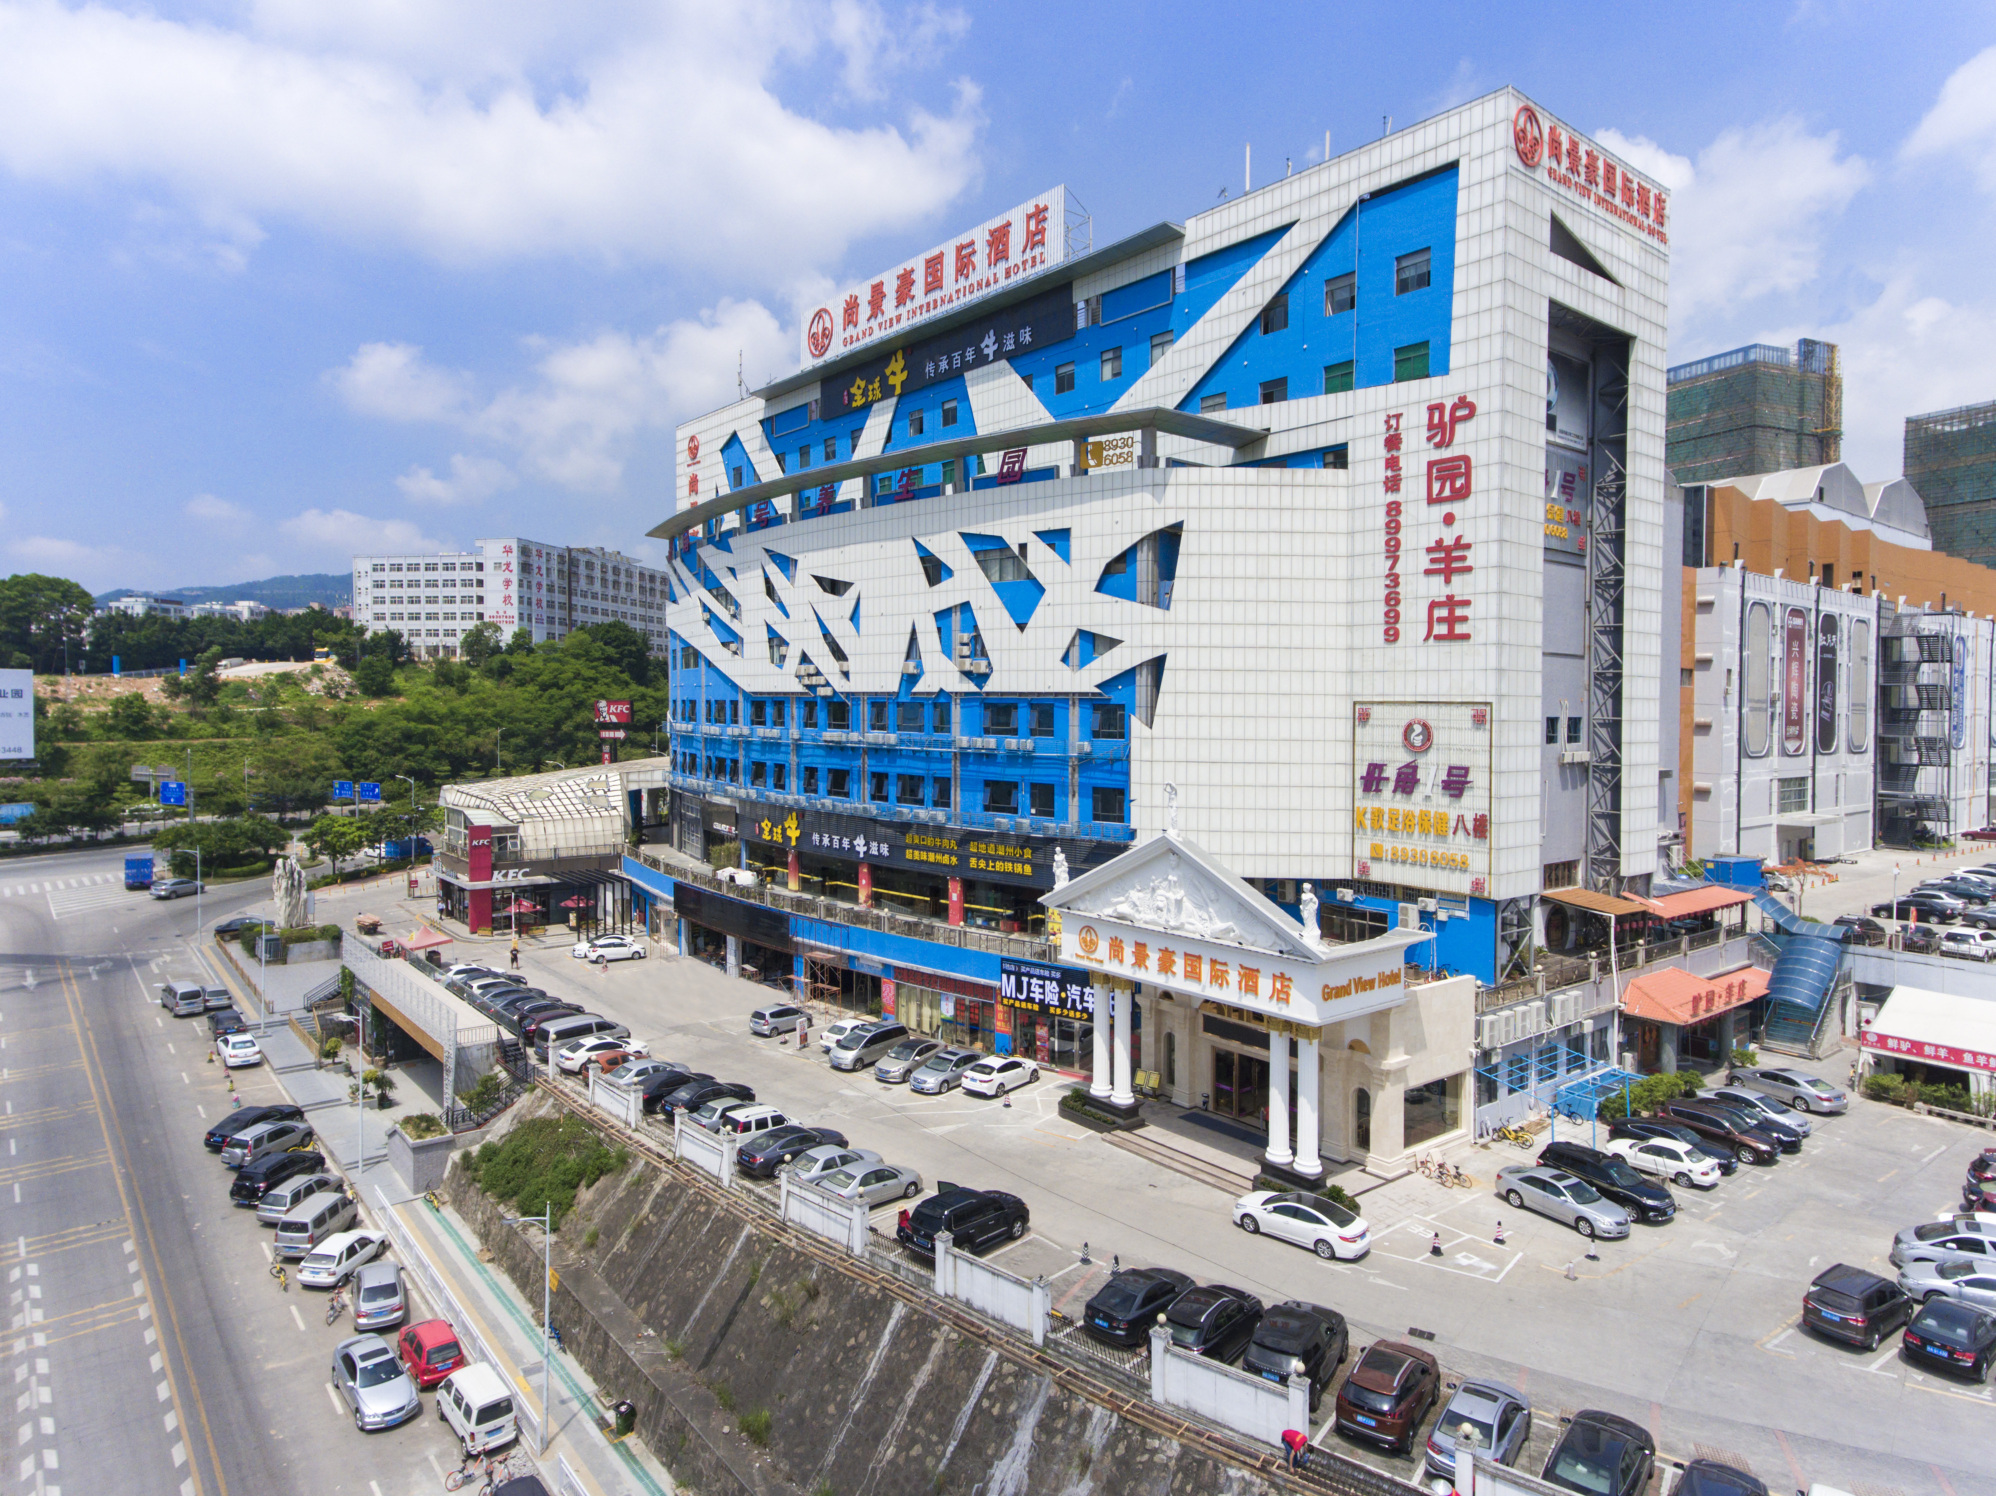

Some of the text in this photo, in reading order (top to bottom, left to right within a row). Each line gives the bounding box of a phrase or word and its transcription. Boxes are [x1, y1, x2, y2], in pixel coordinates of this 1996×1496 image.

[1547, 124, 1667, 228] 尚景豪国际酒店
[1547, 166, 1668, 244] GRAND VIEW INTERNATIONAL HOTEL
[842, 203, 1049, 331] 尚景豪国际酒店
[842, 251, 1046, 346] GRAND VIEW INTERNATIONAL HOTEL
[925, 326, 1033, 380] 传承百年牛滋味
[1103, 436, 1134, 450] 8930
[1103, 451, 1134, 466] 6058
[1383, 412, 1404, 643] 订餐电话 89973699
[609, 704, 630, 713] KFC
[1355, 806, 1489, 840] K歌足浴保健 八楼
[471, 838, 491, 847] KFC
[812, 834, 890, 858] 传承百年牛滋味
[905, 833, 958, 850] 超爽口的牛肉丸
[491, 868, 530, 883] KFC
[969, 857, 1033, 876] 舌尖上的铁锅鱼
[1108, 936, 1294, 1005] 尚景豪国际酒店
[1321, 967, 1402, 1002] Grand View Hotel
